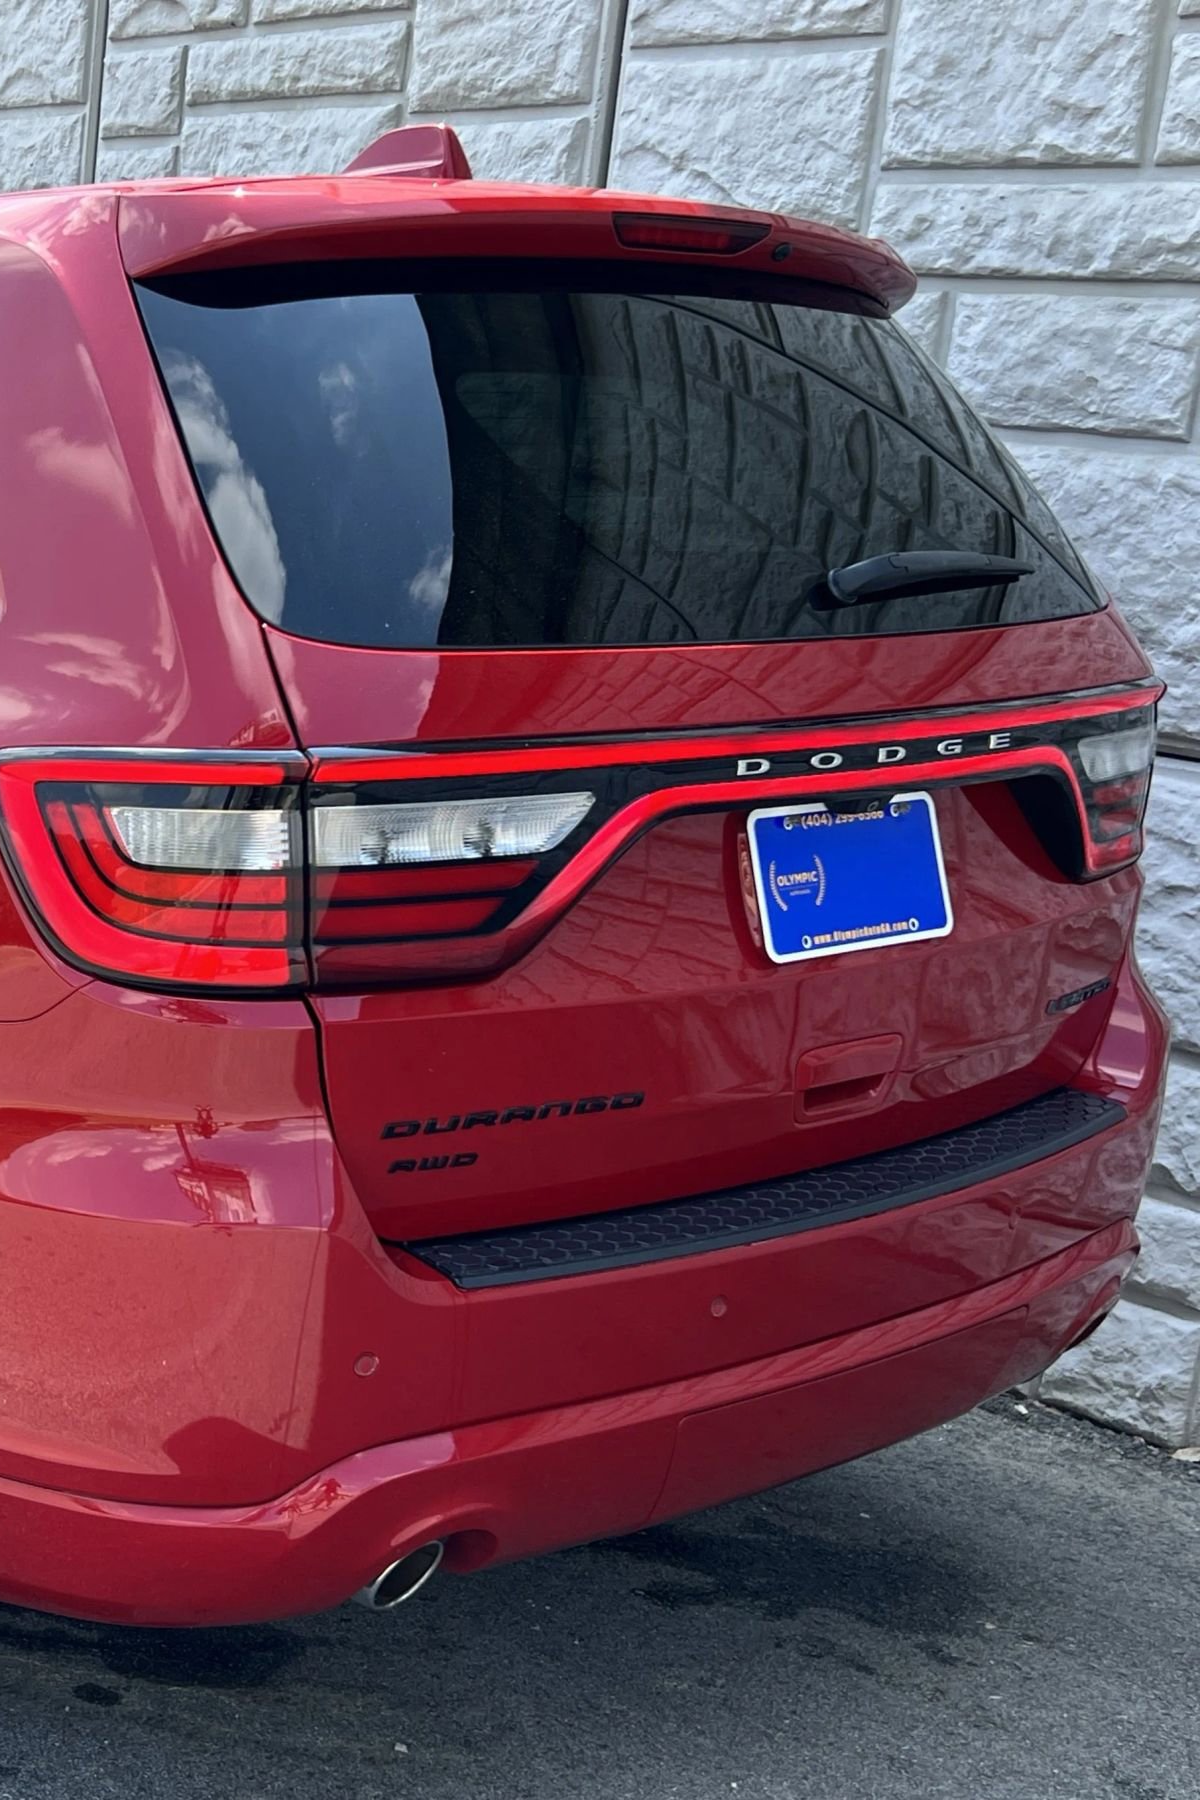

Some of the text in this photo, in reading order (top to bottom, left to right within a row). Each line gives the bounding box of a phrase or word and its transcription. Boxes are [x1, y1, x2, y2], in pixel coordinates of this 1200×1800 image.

[736, 732, 1011, 777] DODGE
[801, 813, 833, 829] (404)
[777, 870, 819, 887] OLYMPIC
[379, 1090, 646, 1140] DURANGO
[386, 1151, 479, 1174] AWD
